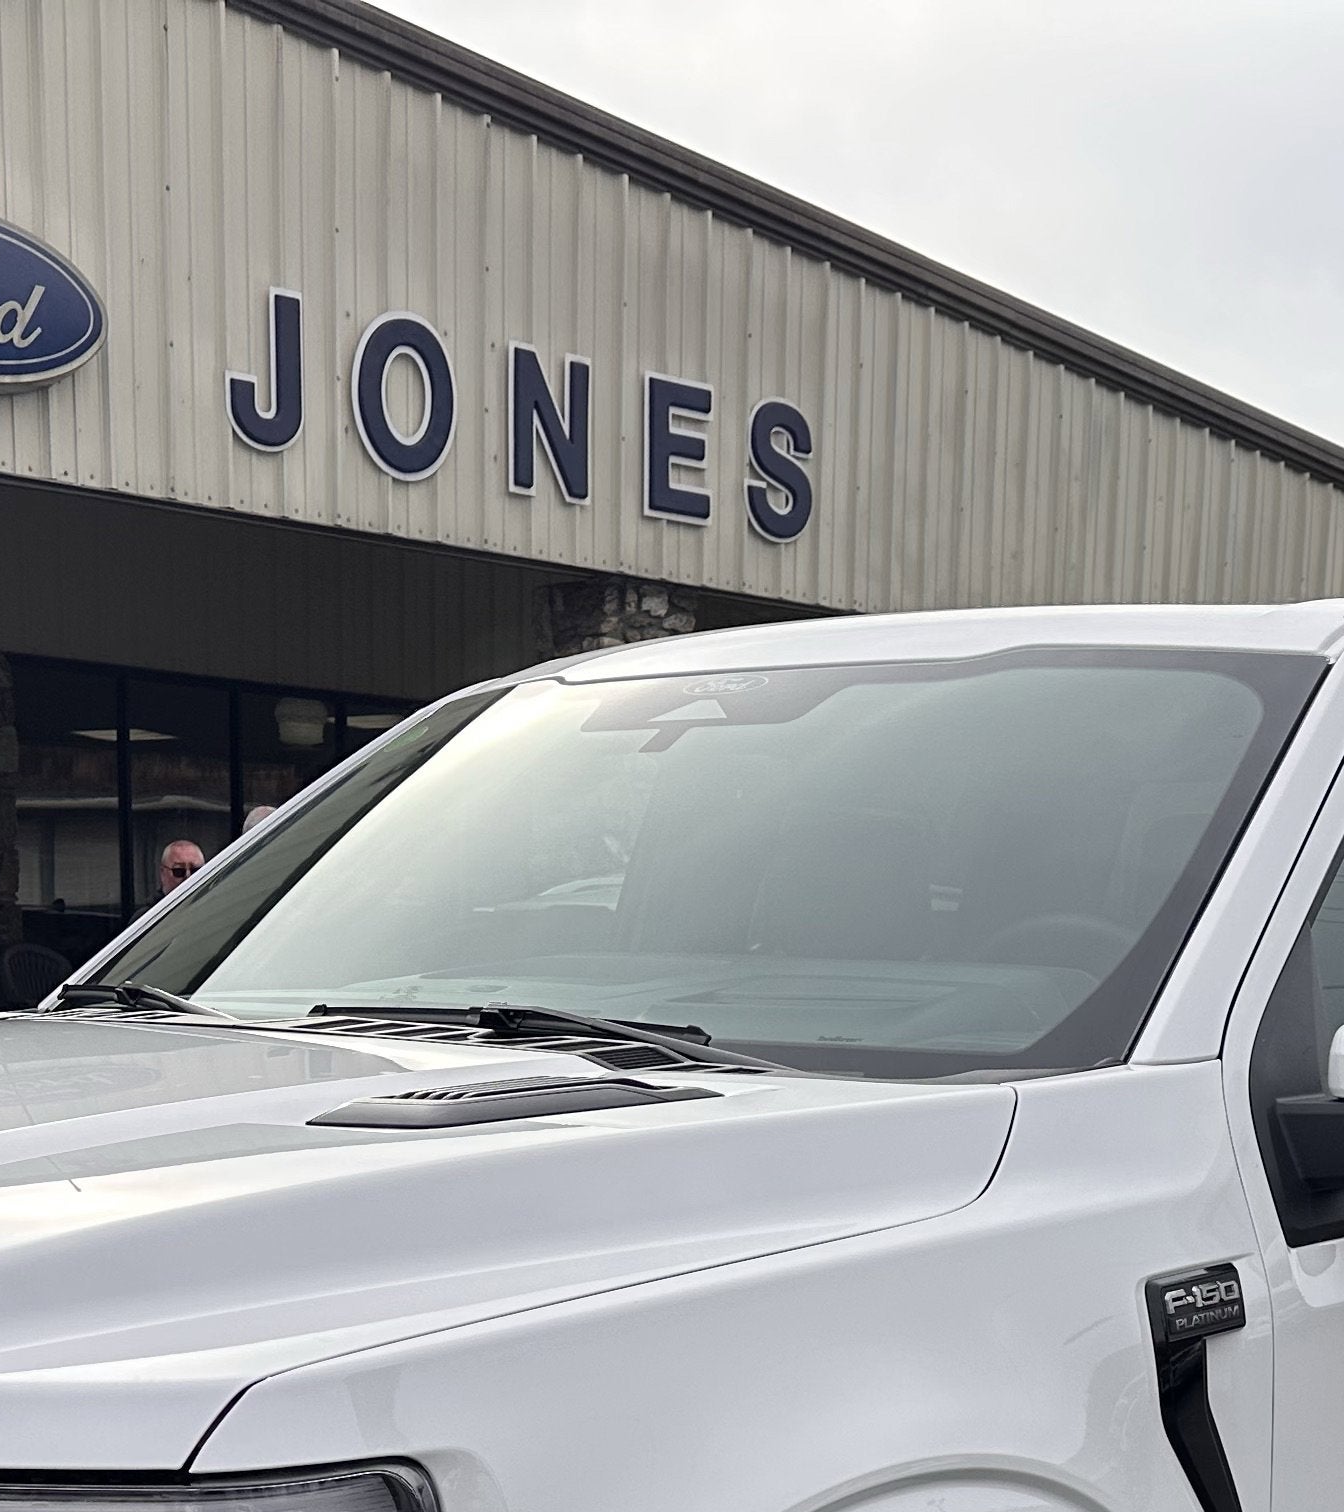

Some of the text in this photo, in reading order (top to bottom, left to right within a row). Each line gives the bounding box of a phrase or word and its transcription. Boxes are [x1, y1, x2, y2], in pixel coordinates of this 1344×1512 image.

[224, 285, 814, 543] JONES
[1165, 1280, 1241, 1315] F-150
[1176, 1305, 1239, 1331] PLATINUM
